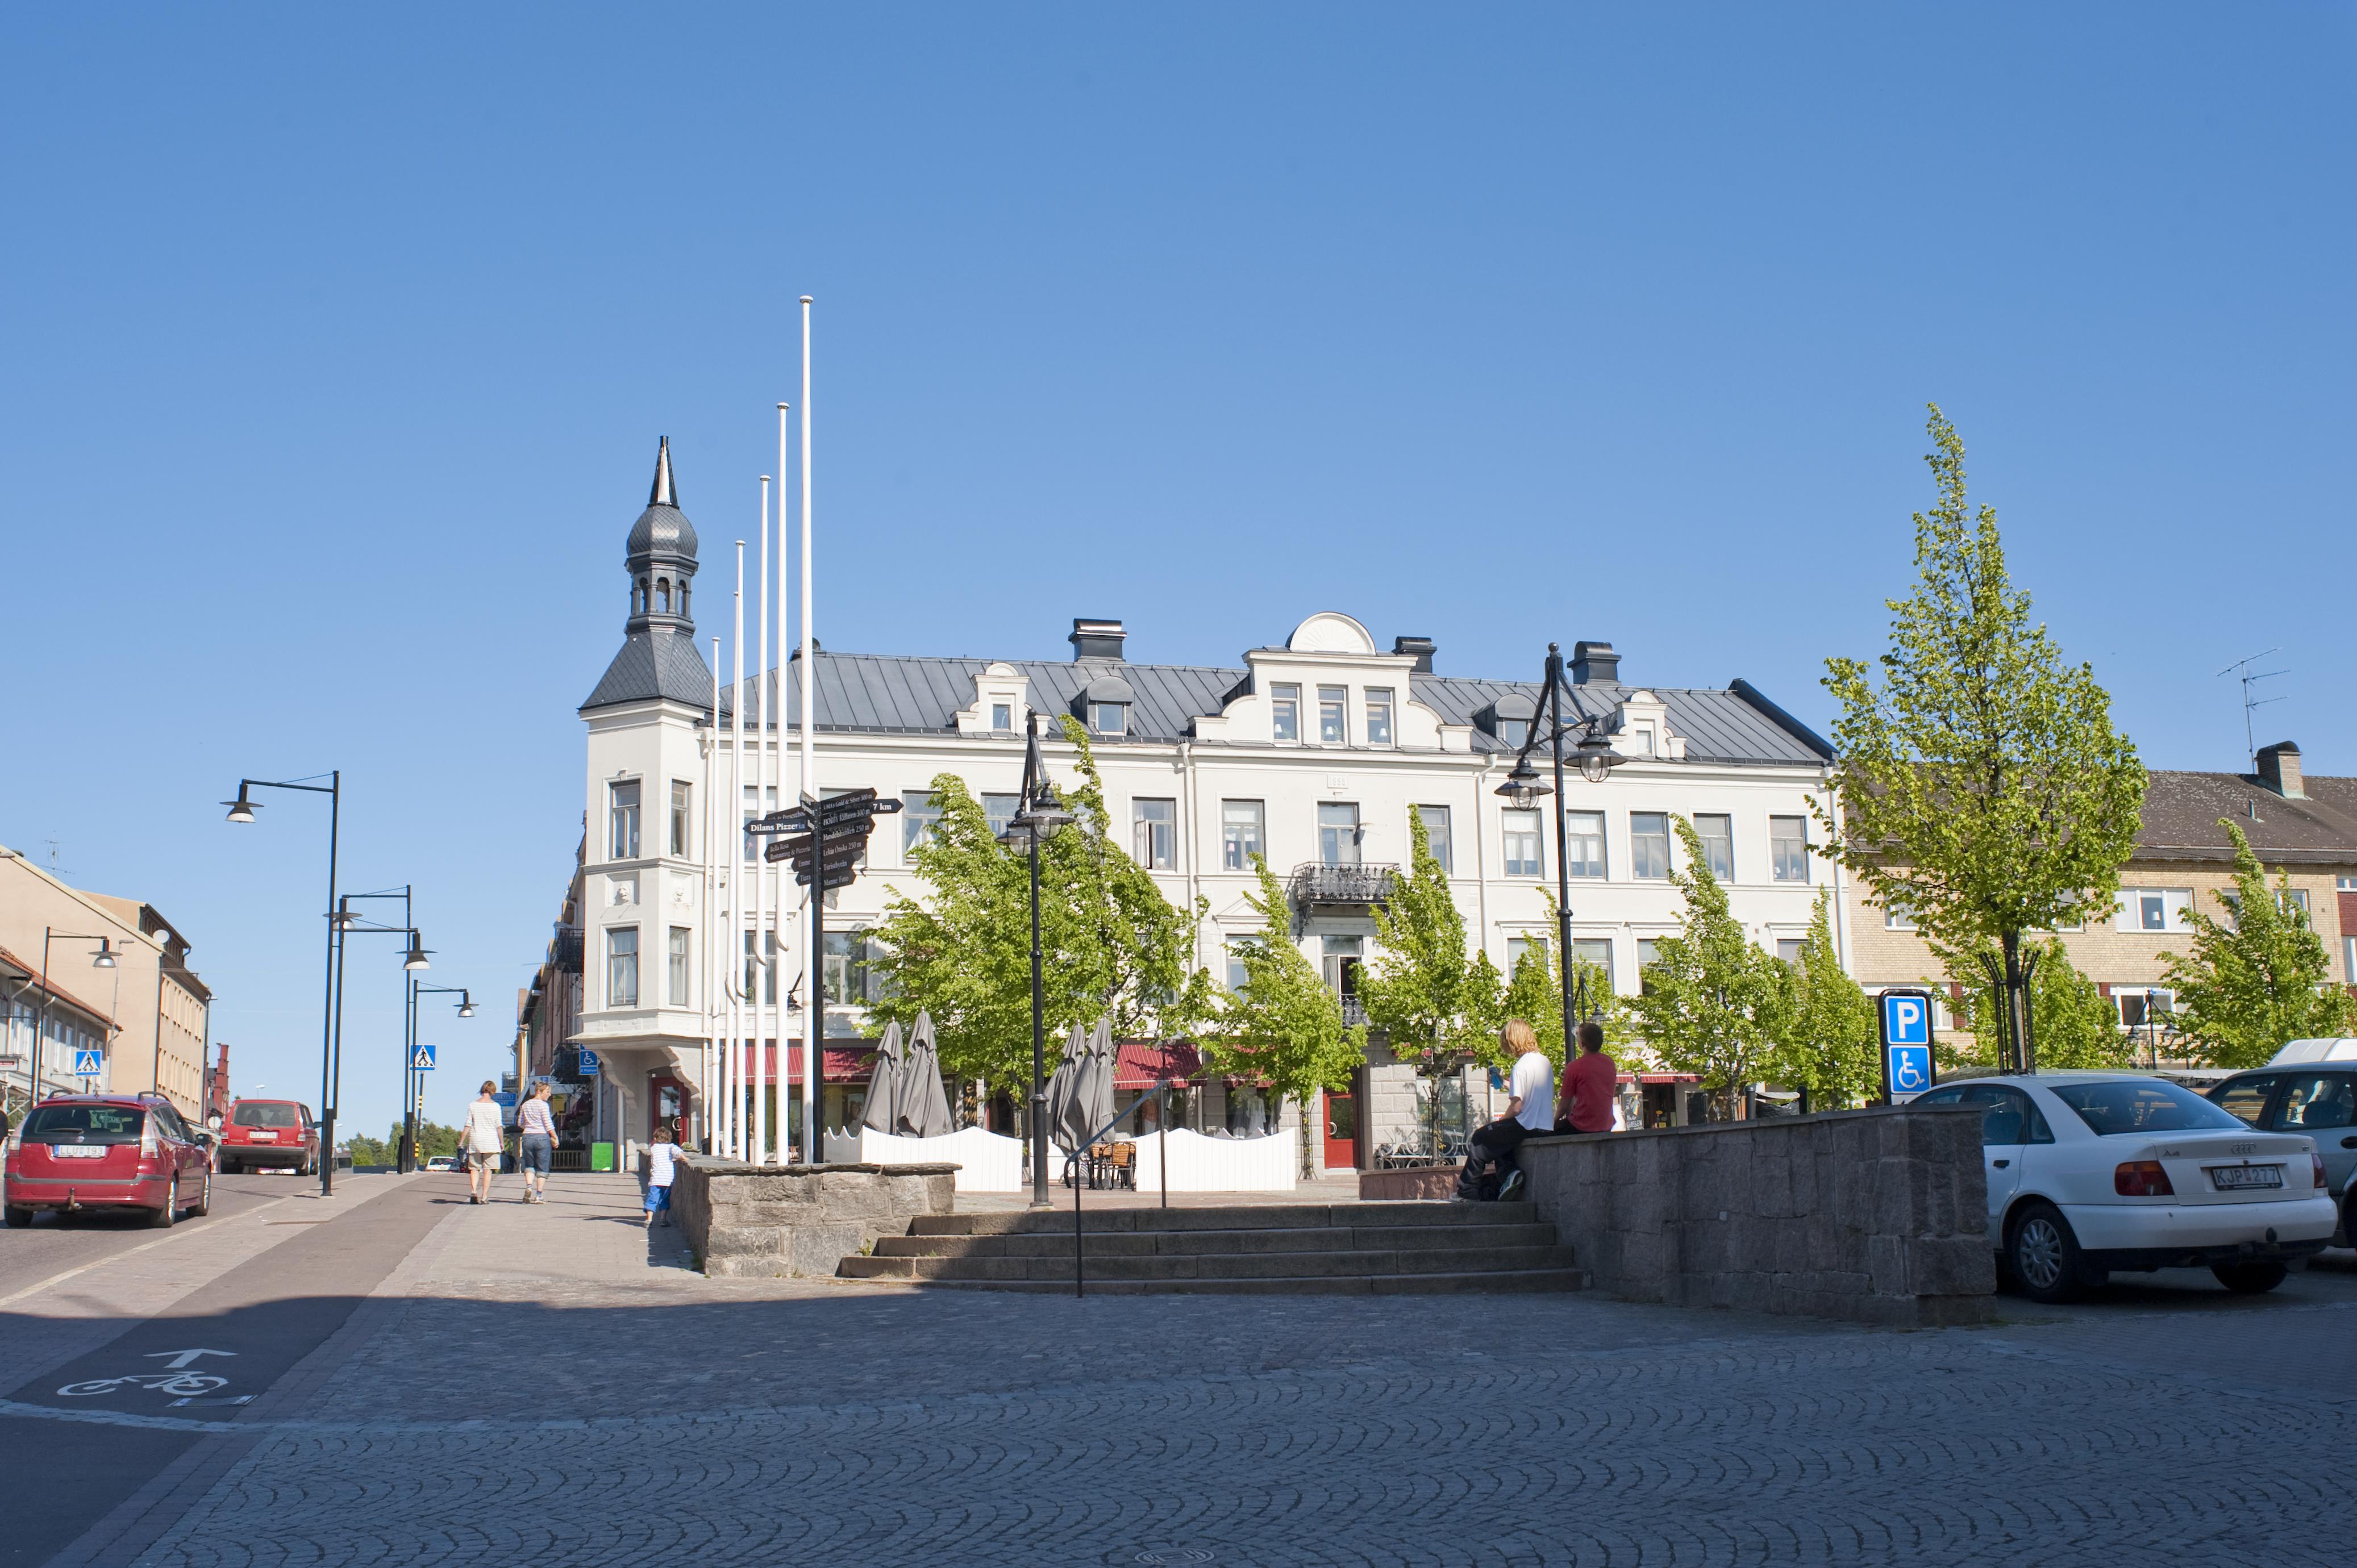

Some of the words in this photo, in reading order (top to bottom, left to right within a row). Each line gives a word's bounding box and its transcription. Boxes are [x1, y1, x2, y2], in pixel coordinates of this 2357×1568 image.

[776, 822, 805, 831] Pizzeria
[823, 827, 855, 841] Handelsbanken
[823, 860, 847, 871] Turistbyrån
[1897, 1002, 1919, 1039] P
[2216, 1169, 2242, 1184] KJP
[2252, 1168, 2276, 1183] 277
